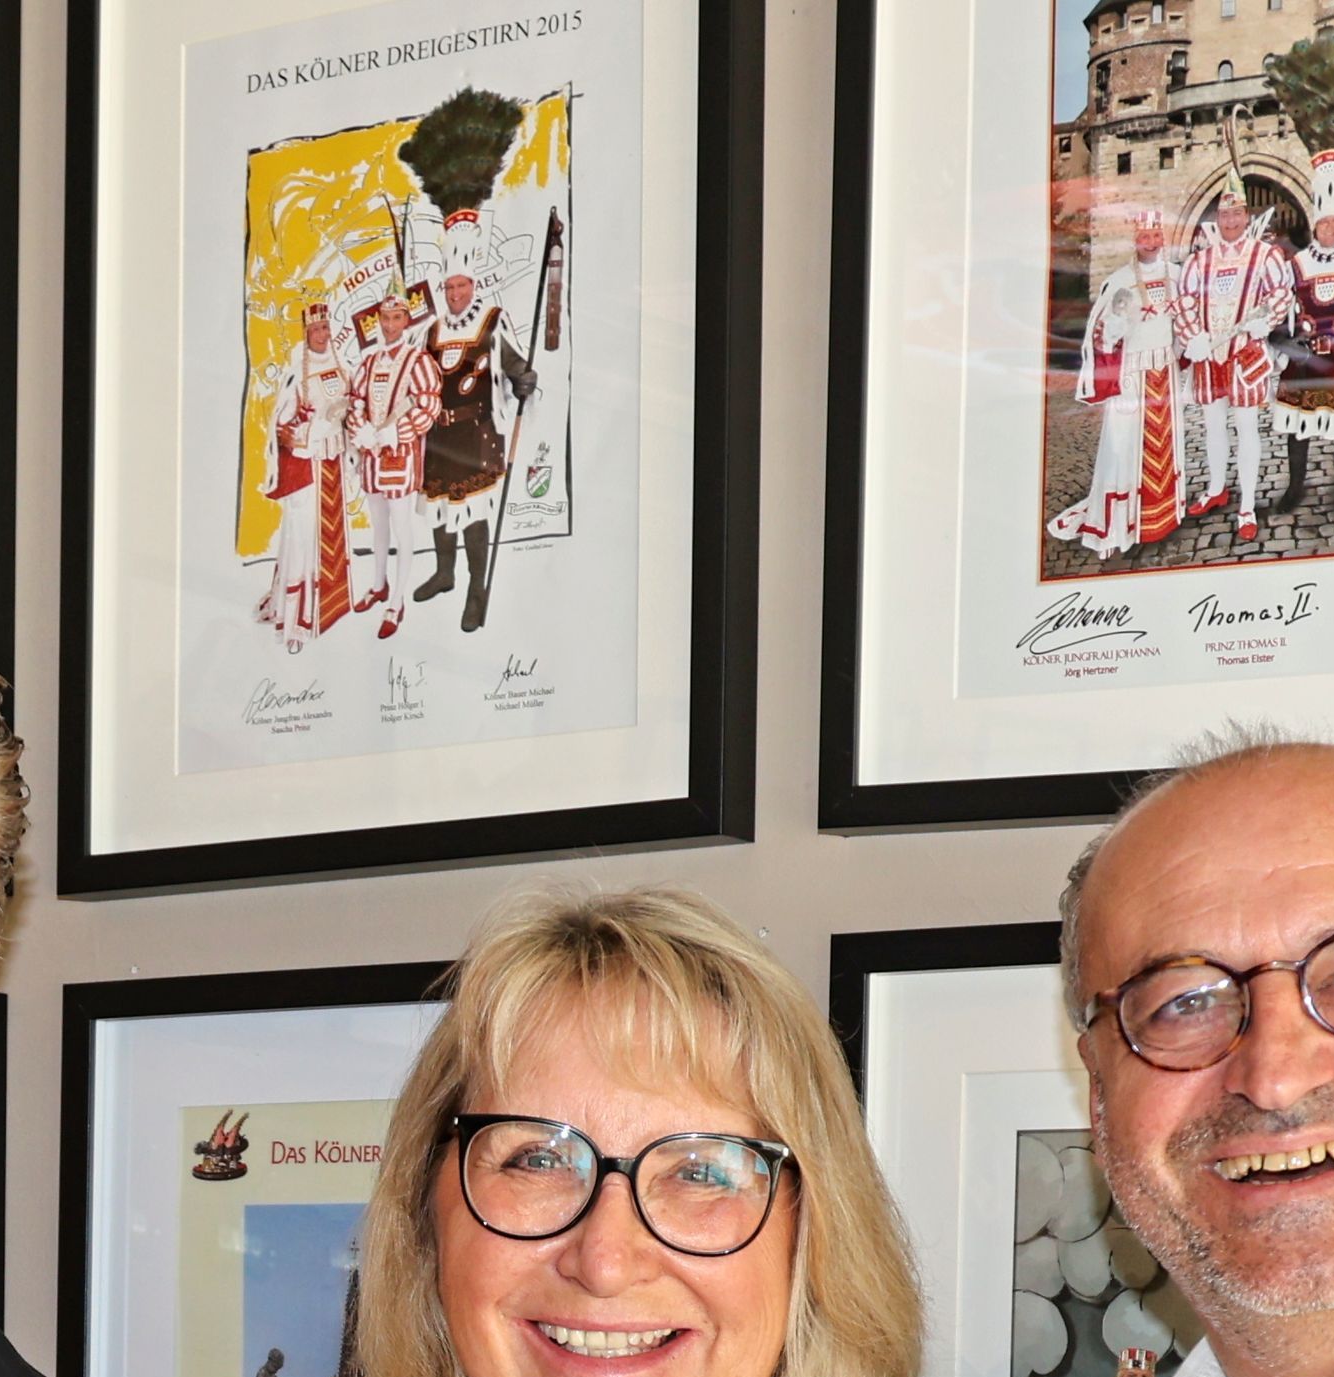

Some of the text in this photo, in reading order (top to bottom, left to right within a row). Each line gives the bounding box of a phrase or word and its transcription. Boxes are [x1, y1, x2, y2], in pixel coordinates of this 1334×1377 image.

[247, 10, 583, 94] DAS KÖLNER DREIGESTIRN 2015
[343, 254, 396, 294] HOLGE
[1188, 594, 1284, 632] Thomas
[1116, 647, 1161, 659] JOHANNA
[1205, 641, 1234, 652] PRINZ
[1238, 638, 1275, 649] THOMAS
[1217, 655, 1249, 665] Thomas
[1083, 665, 1118, 676] Hertzner
[314, 1140, 382, 1164] KÖLNER
